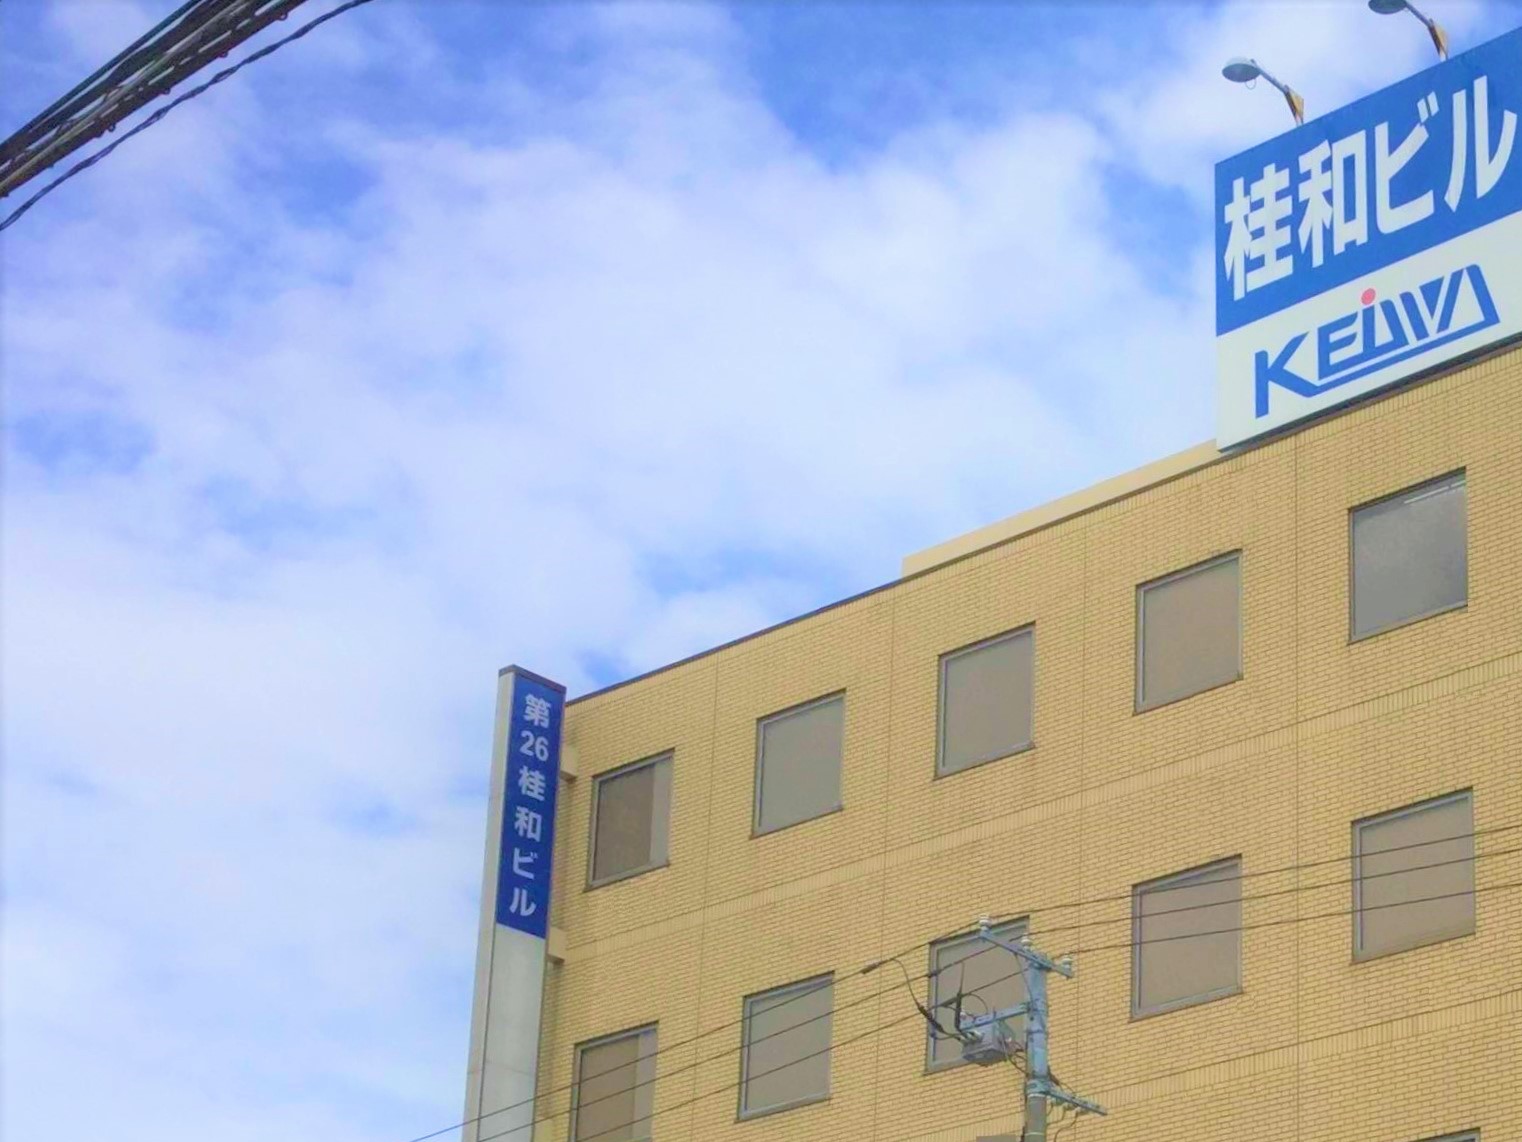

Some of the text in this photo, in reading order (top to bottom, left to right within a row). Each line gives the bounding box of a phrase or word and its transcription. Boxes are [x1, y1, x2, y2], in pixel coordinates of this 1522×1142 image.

[1224, 75, 1517, 301] 桂和ビル
[509, 694, 551, 917] 第26桂和ビル
